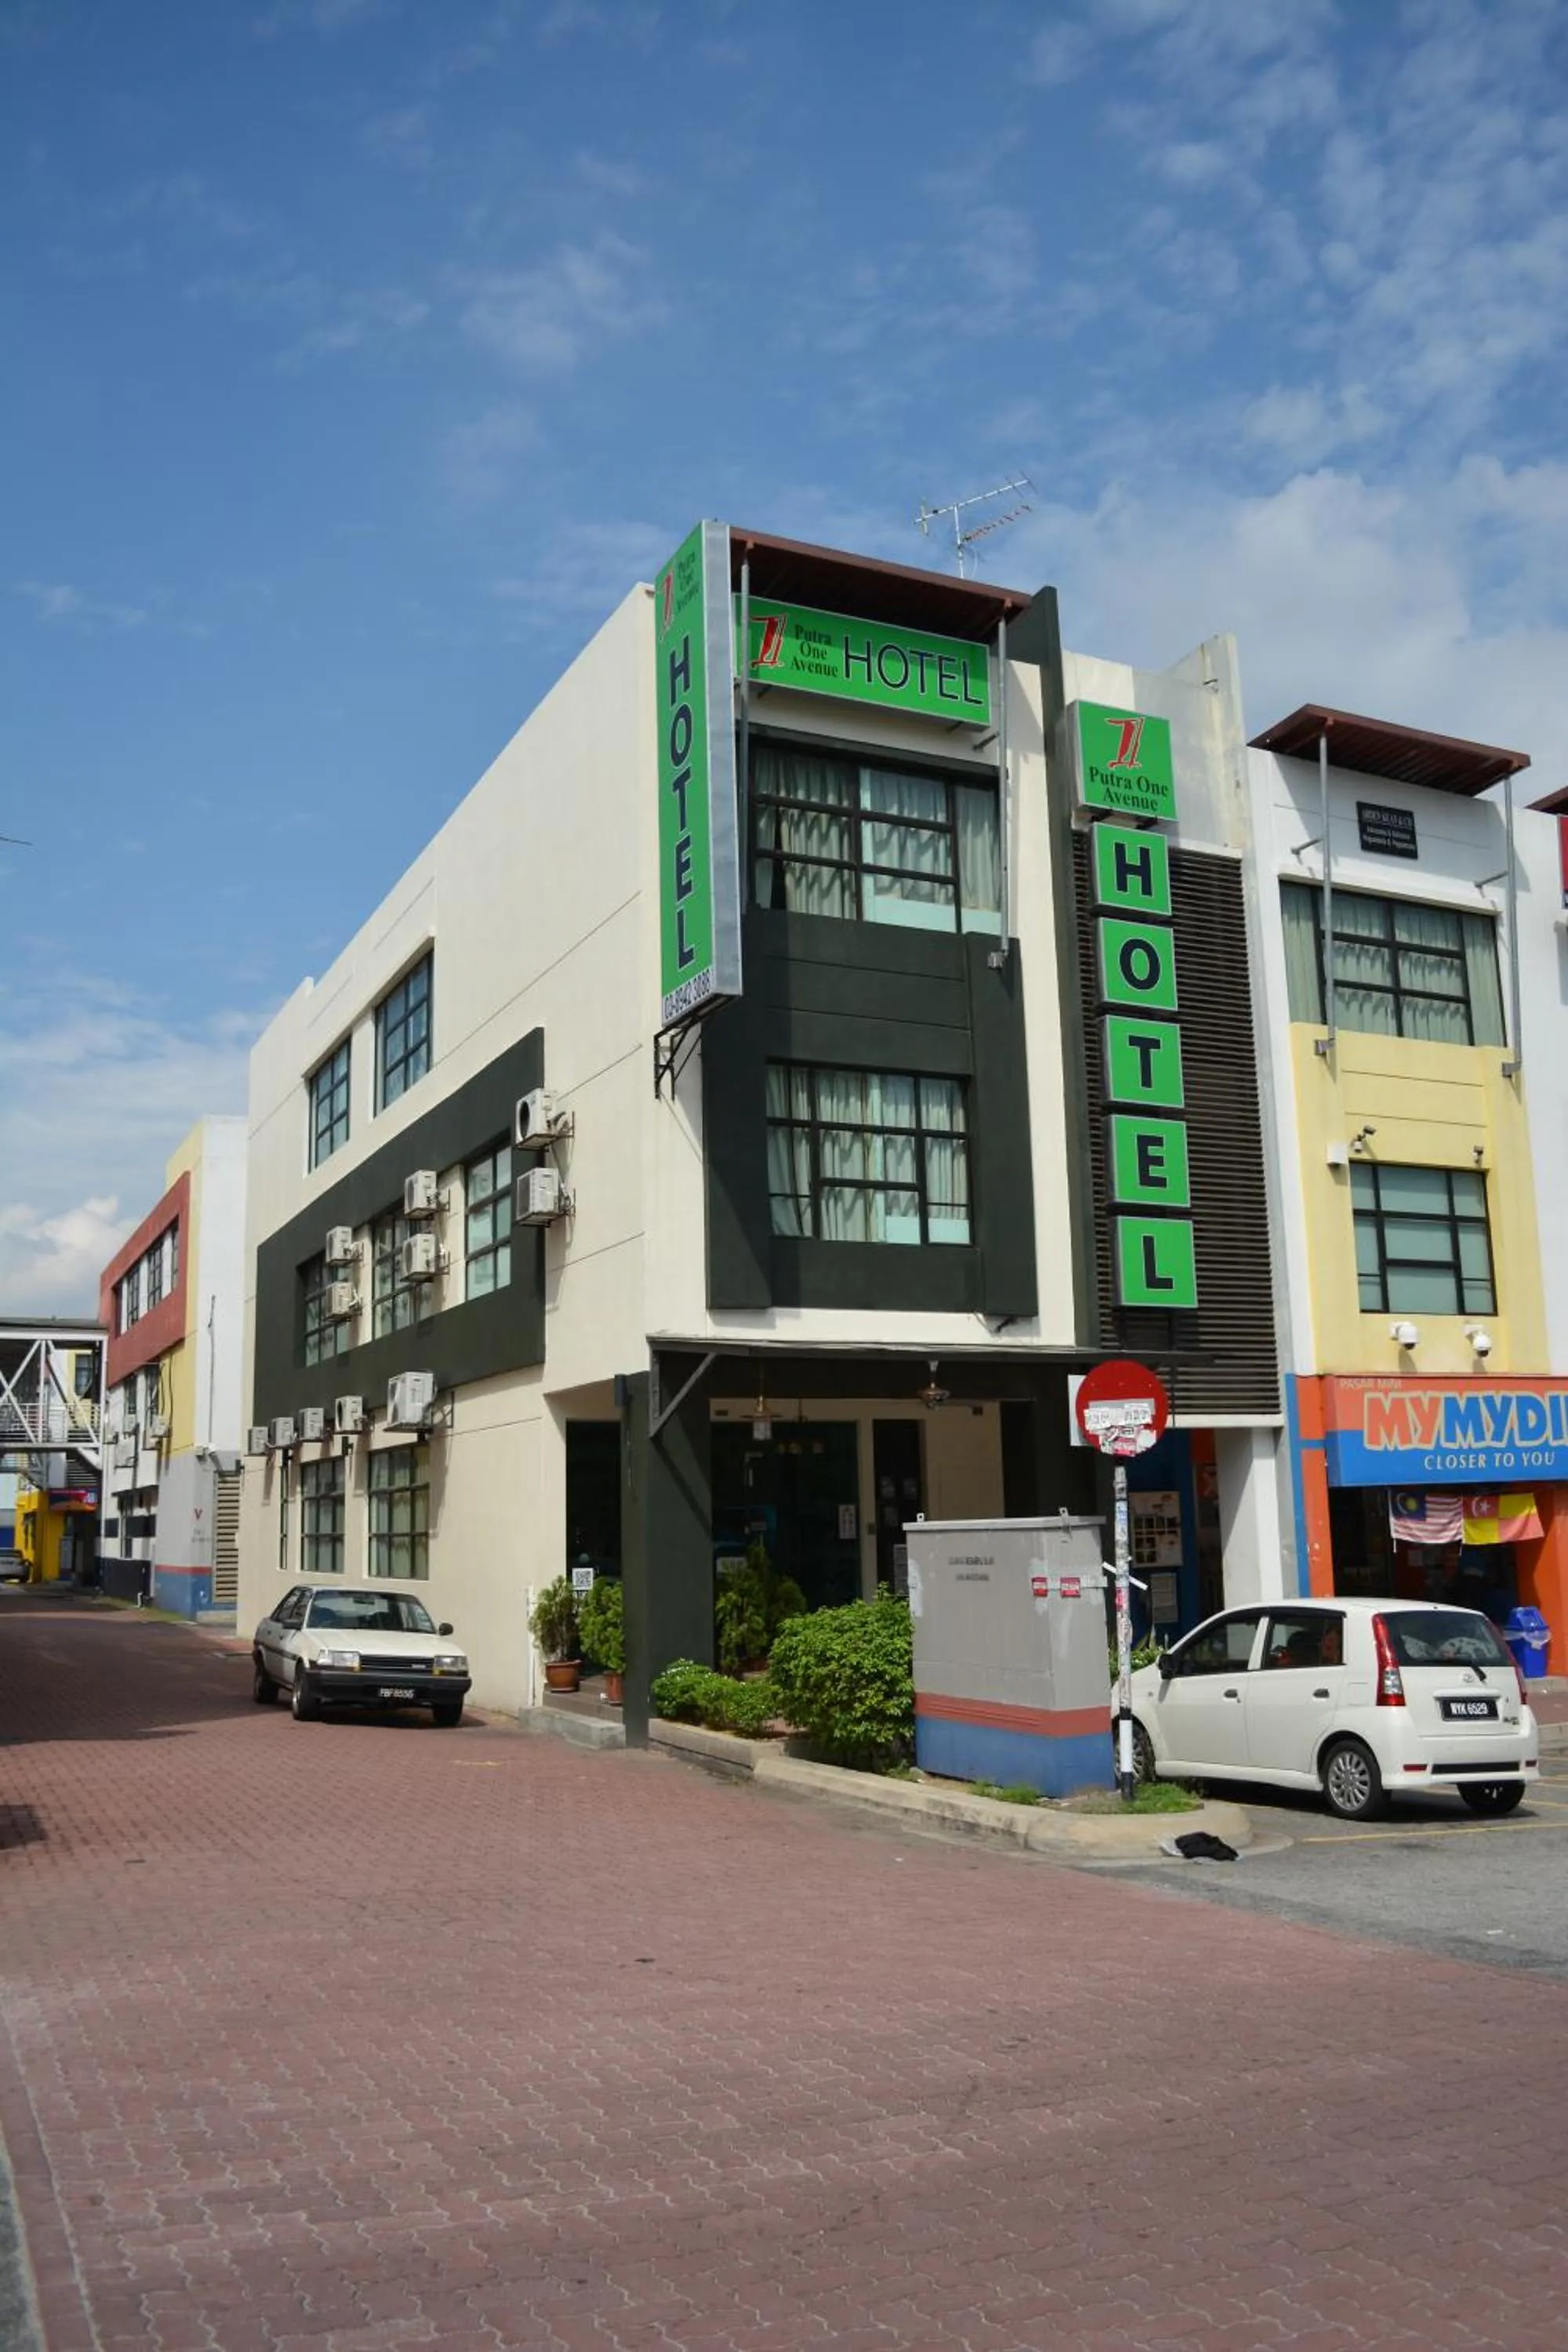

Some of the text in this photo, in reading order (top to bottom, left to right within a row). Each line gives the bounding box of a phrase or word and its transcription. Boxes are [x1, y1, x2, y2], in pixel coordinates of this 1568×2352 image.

[793, 623, 833, 646] Putra
[799, 641, 828, 660] One
[790, 655, 839, 679] Avenue
[843, 634, 983, 706] HOTEL
[1089, 765, 1169, 797] Putra One
[668, 633, 695, 972] HOTEL
[1102, 786, 1159, 812] Avenue
[1113, 840, 1174, 1291] HOTEL
[1424, 1450, 1555, 1471] CLOSER TO YOU
